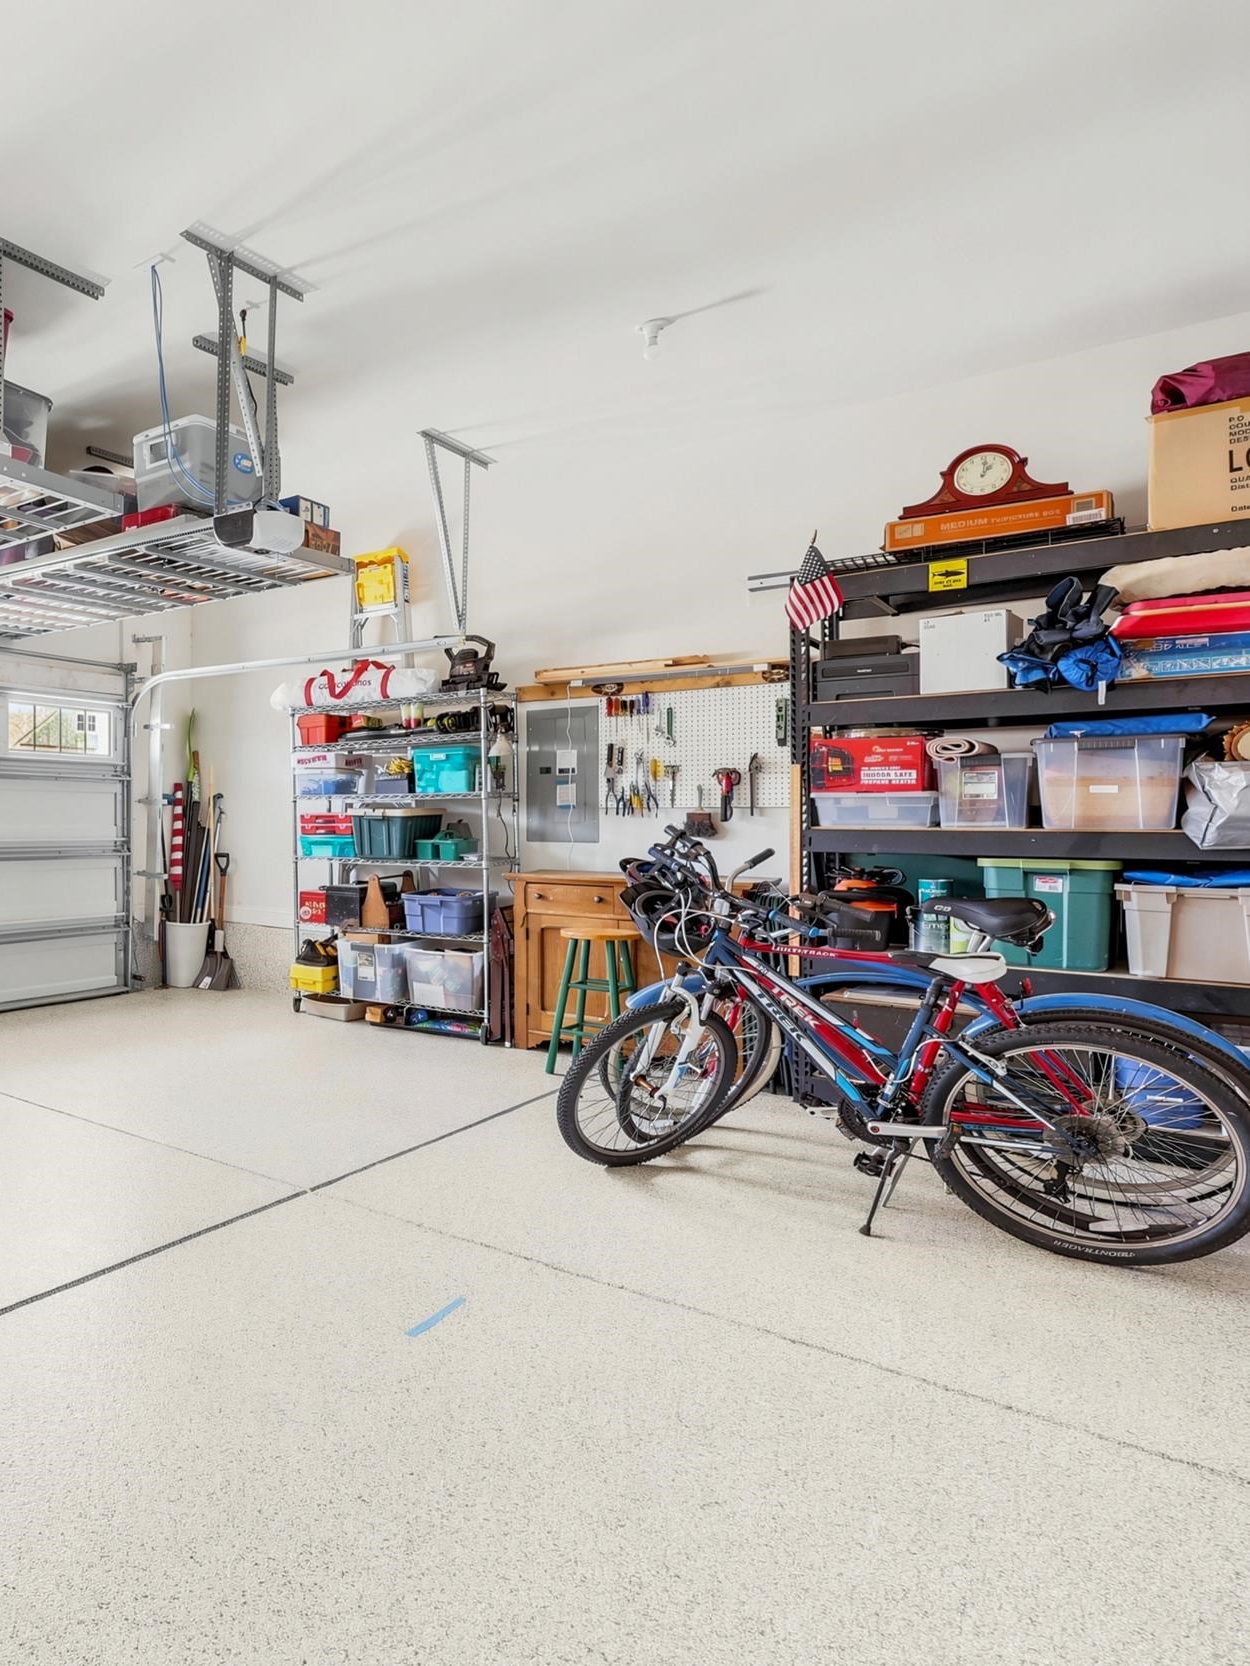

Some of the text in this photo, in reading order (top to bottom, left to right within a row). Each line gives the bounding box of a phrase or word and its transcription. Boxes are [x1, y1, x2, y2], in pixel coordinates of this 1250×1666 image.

[940, 517, 988, 531] MEDIUM
[756, 988, 807, 1042] TREK
[771, 986, 821, 1029] TREK
